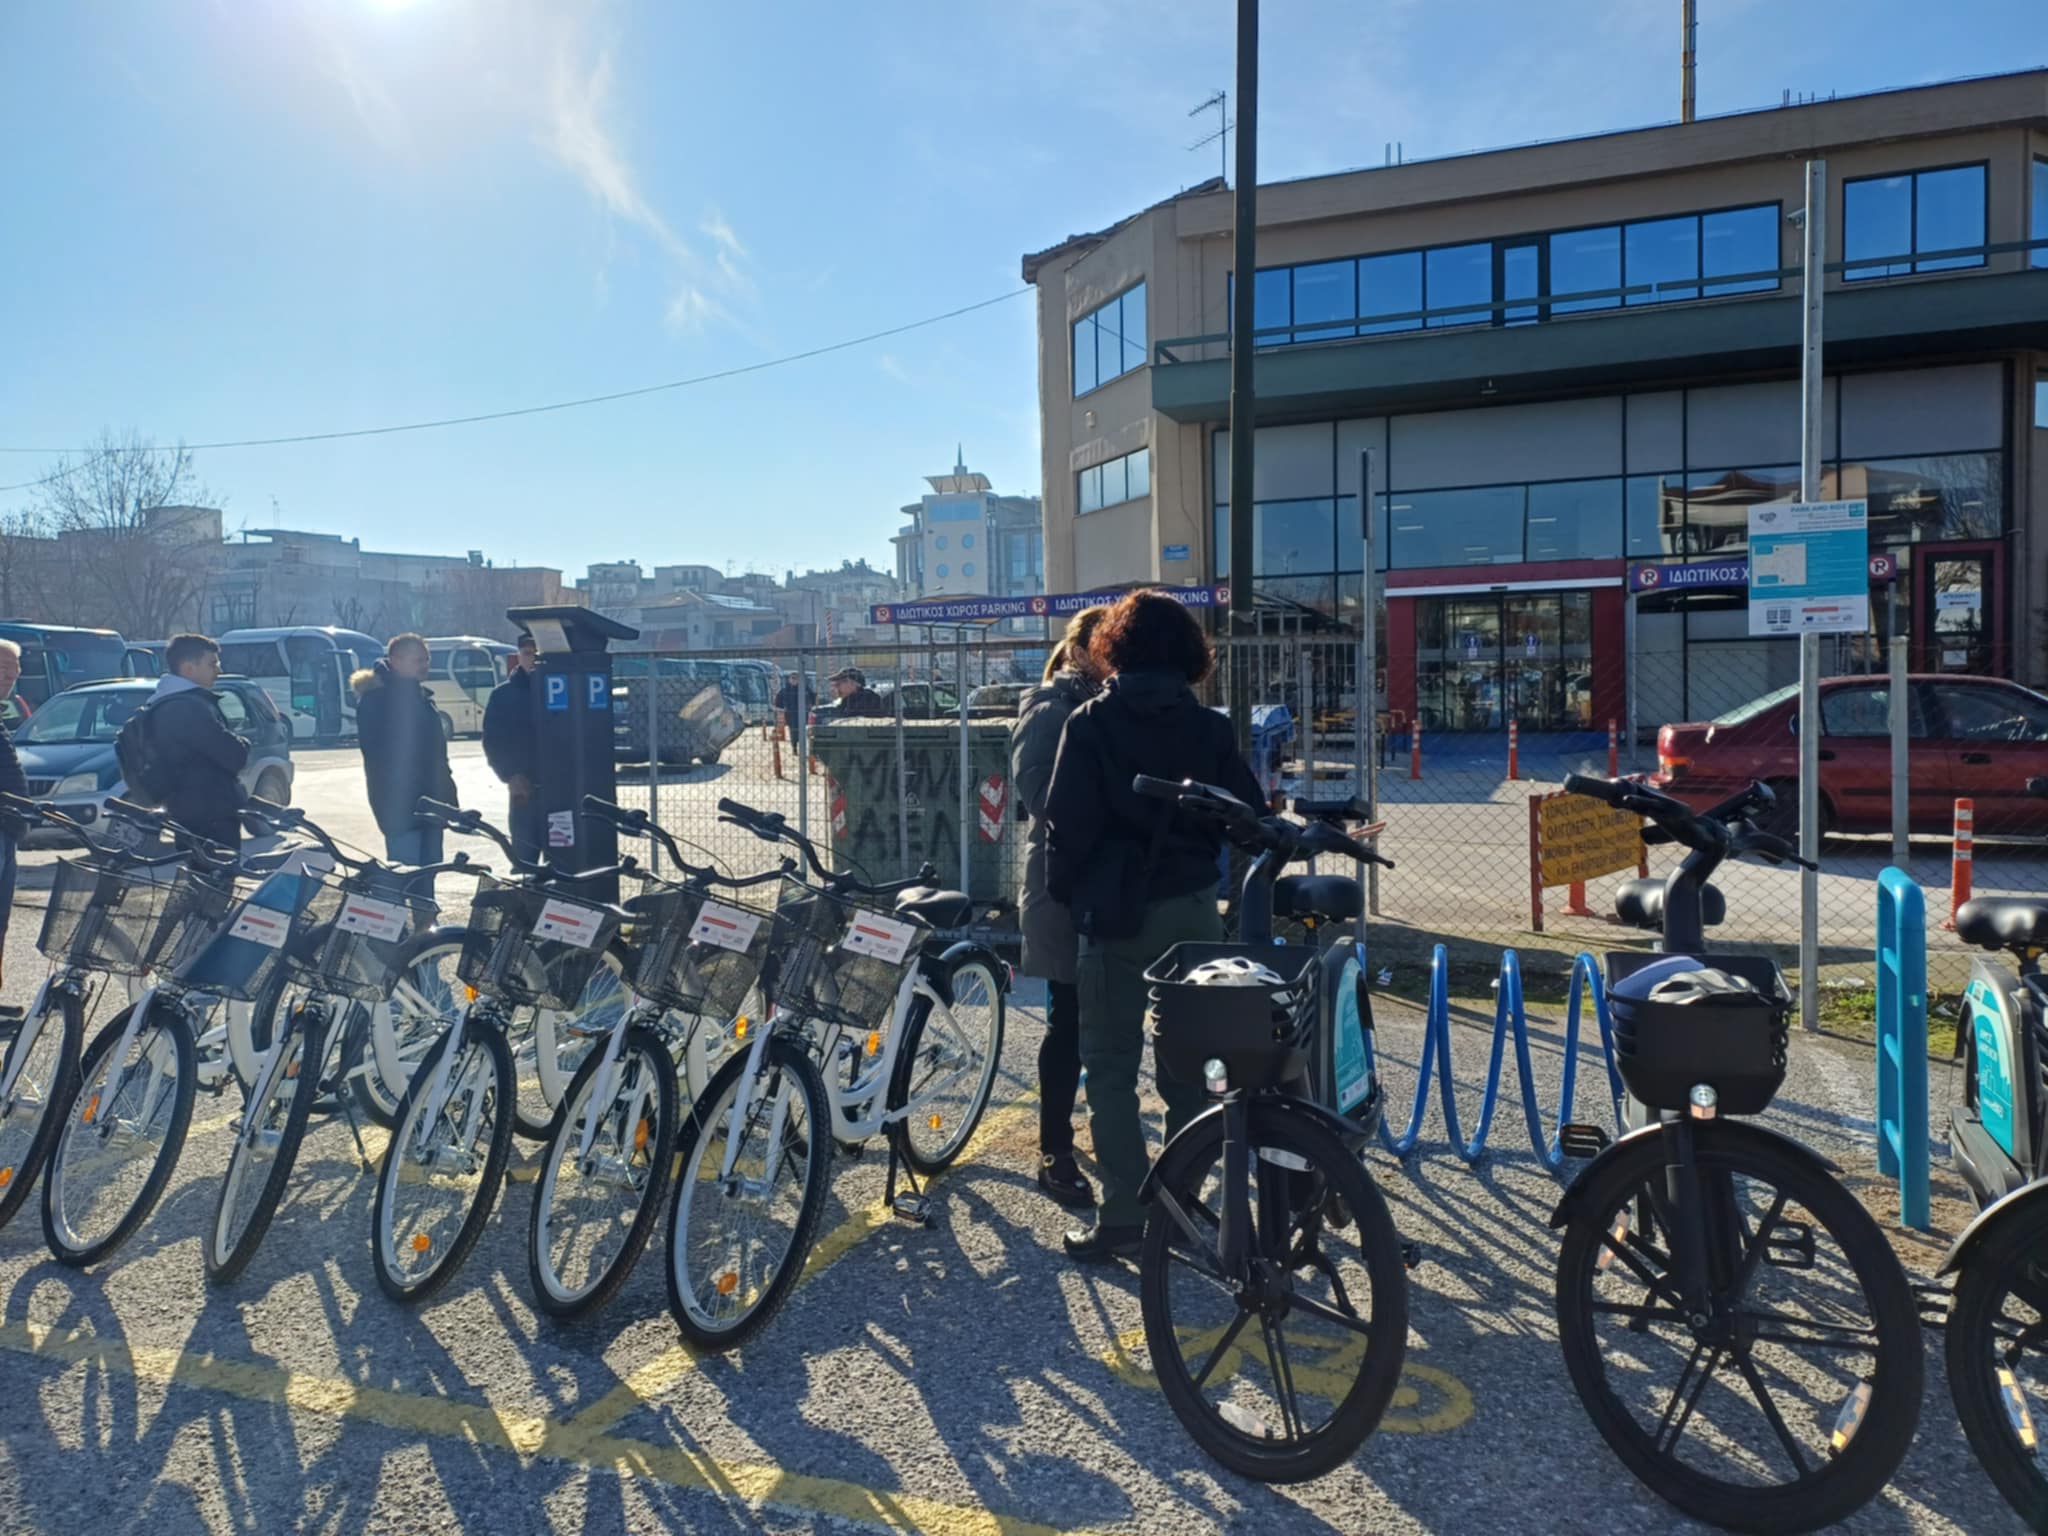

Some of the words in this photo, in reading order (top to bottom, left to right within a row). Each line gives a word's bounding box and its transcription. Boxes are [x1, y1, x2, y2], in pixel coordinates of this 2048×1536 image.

[1669, 567, 1738, 583] ΙΔΙΩΤΙΚΟΣ
[896, 607, 945, 620] ΙΔΙΩΤΙΚΟΣ
[947, 604, 979, 617] ΧΩΡΟΣ
[981, 601, 1026, 615] PARKING
